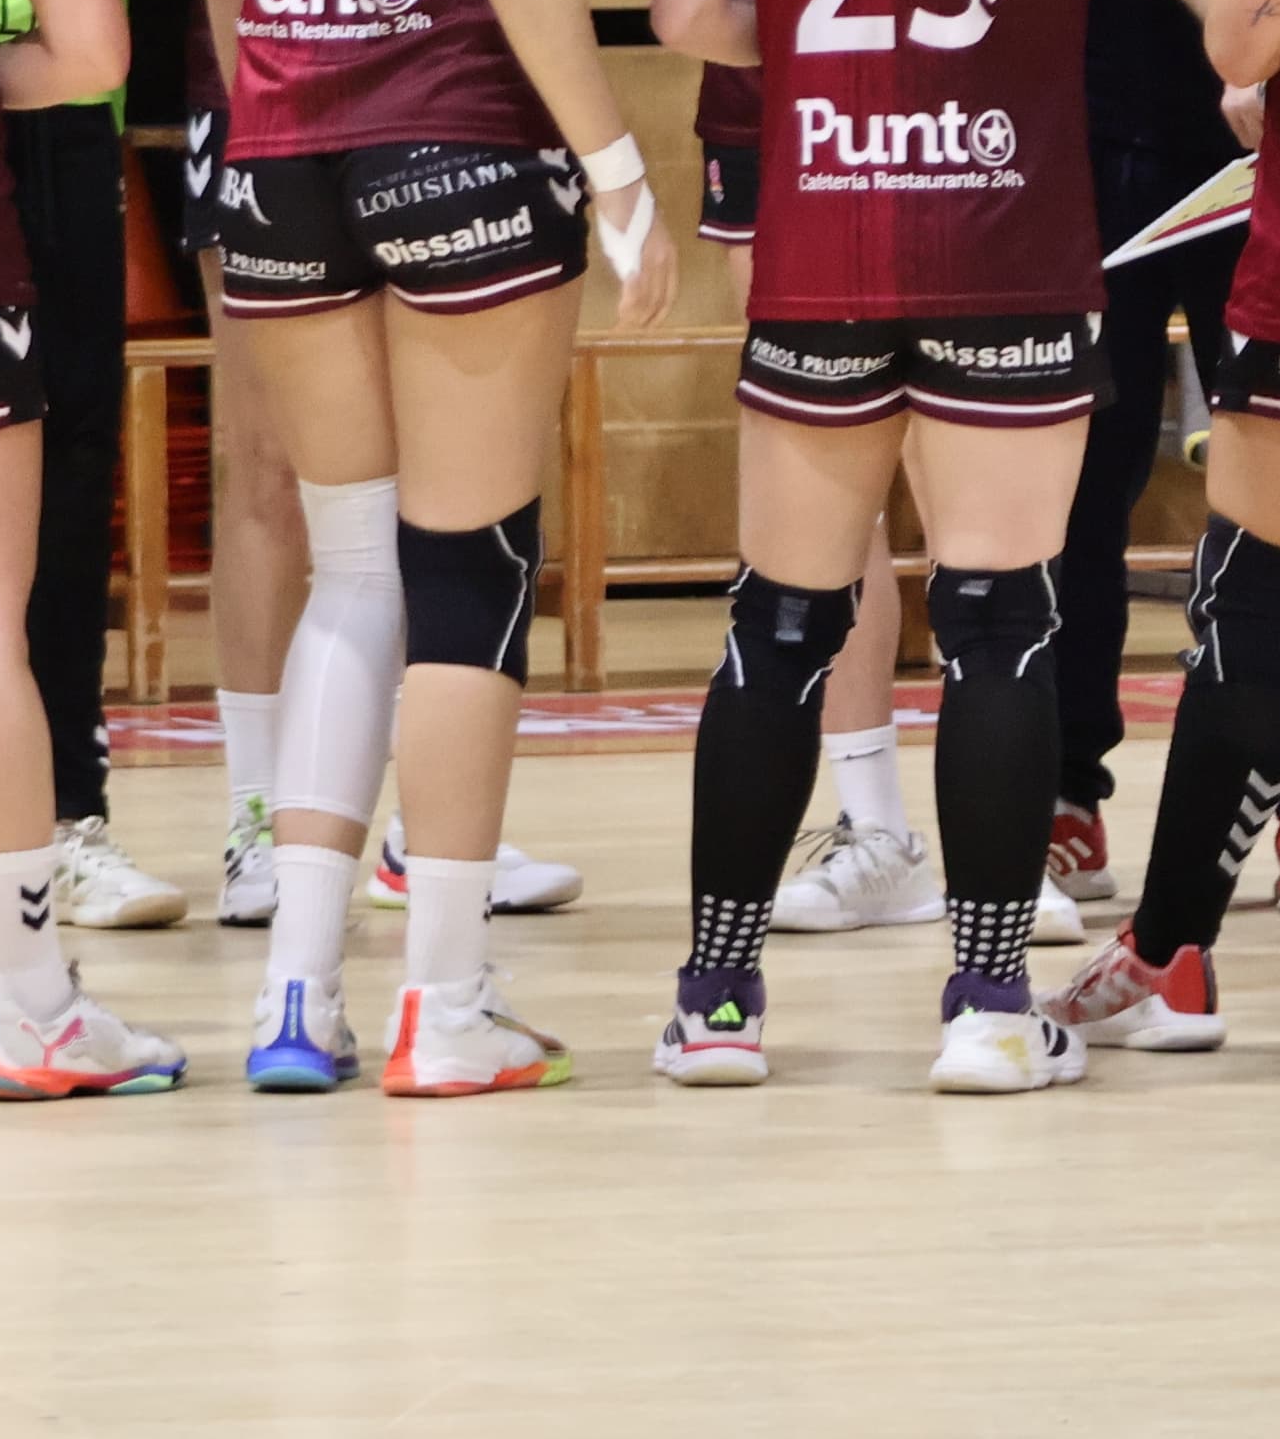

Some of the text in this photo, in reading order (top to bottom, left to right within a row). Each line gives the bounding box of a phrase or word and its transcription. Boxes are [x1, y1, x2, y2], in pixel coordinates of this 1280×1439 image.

[357, 160, 518, 218] LOUISIANA
[873, 168, 989, 191] Restaurante
[373, 204, 534, 267] Dissalud
[920, 330, 1073, 369] Dissalud
